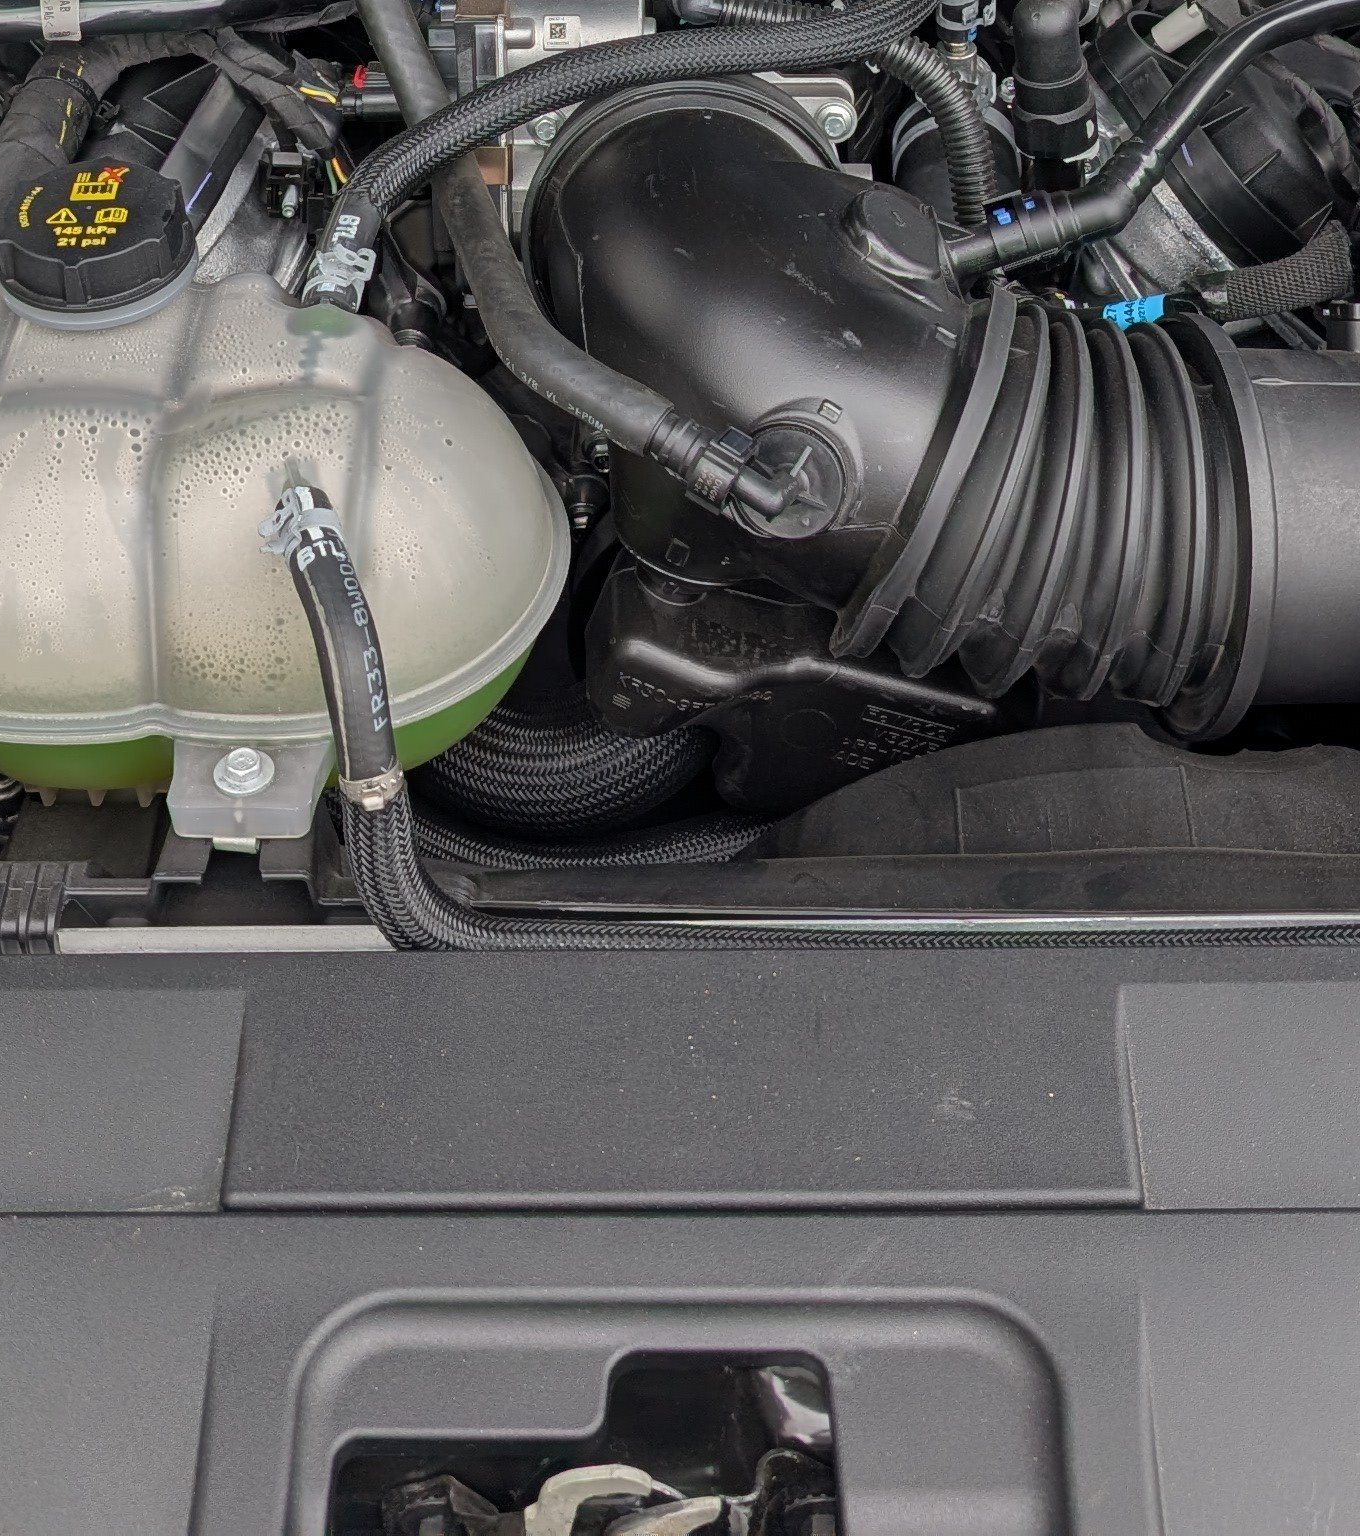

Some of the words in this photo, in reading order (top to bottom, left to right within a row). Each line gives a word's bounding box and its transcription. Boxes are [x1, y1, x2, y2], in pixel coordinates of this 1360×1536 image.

[53, 226, 84, 237] 145
[86, 225, 117, 236] kPa
[56, 238, 77, 248] 21
[80, 237, 106, 248] psi
